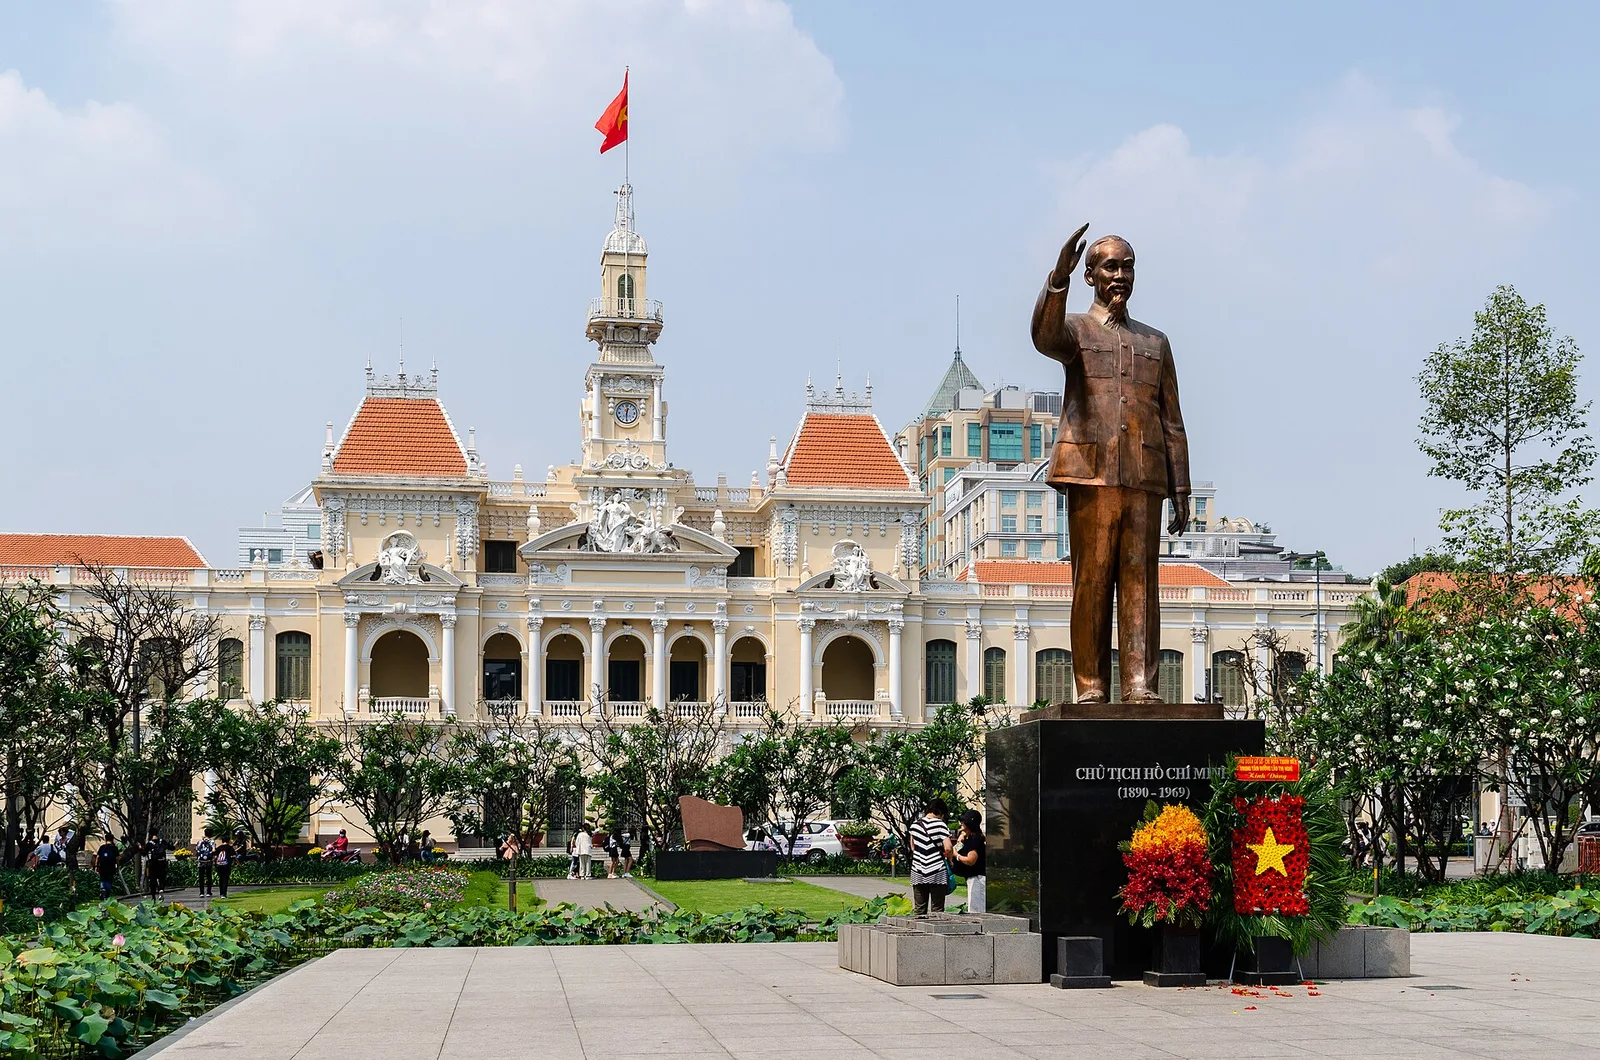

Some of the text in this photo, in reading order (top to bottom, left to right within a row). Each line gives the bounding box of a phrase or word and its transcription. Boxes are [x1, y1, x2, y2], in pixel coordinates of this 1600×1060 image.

[1076, 764, 1105, 780] CHỦ
[1107, 767, 1141, 782] TỊCH
[1143, 762, 1164, 780] HỒ
[1166, 765, 1190, 780] CHÍ
[1117, 786, 1149, 799] (1890
[1159, 786, 1190, 799] 1969)
